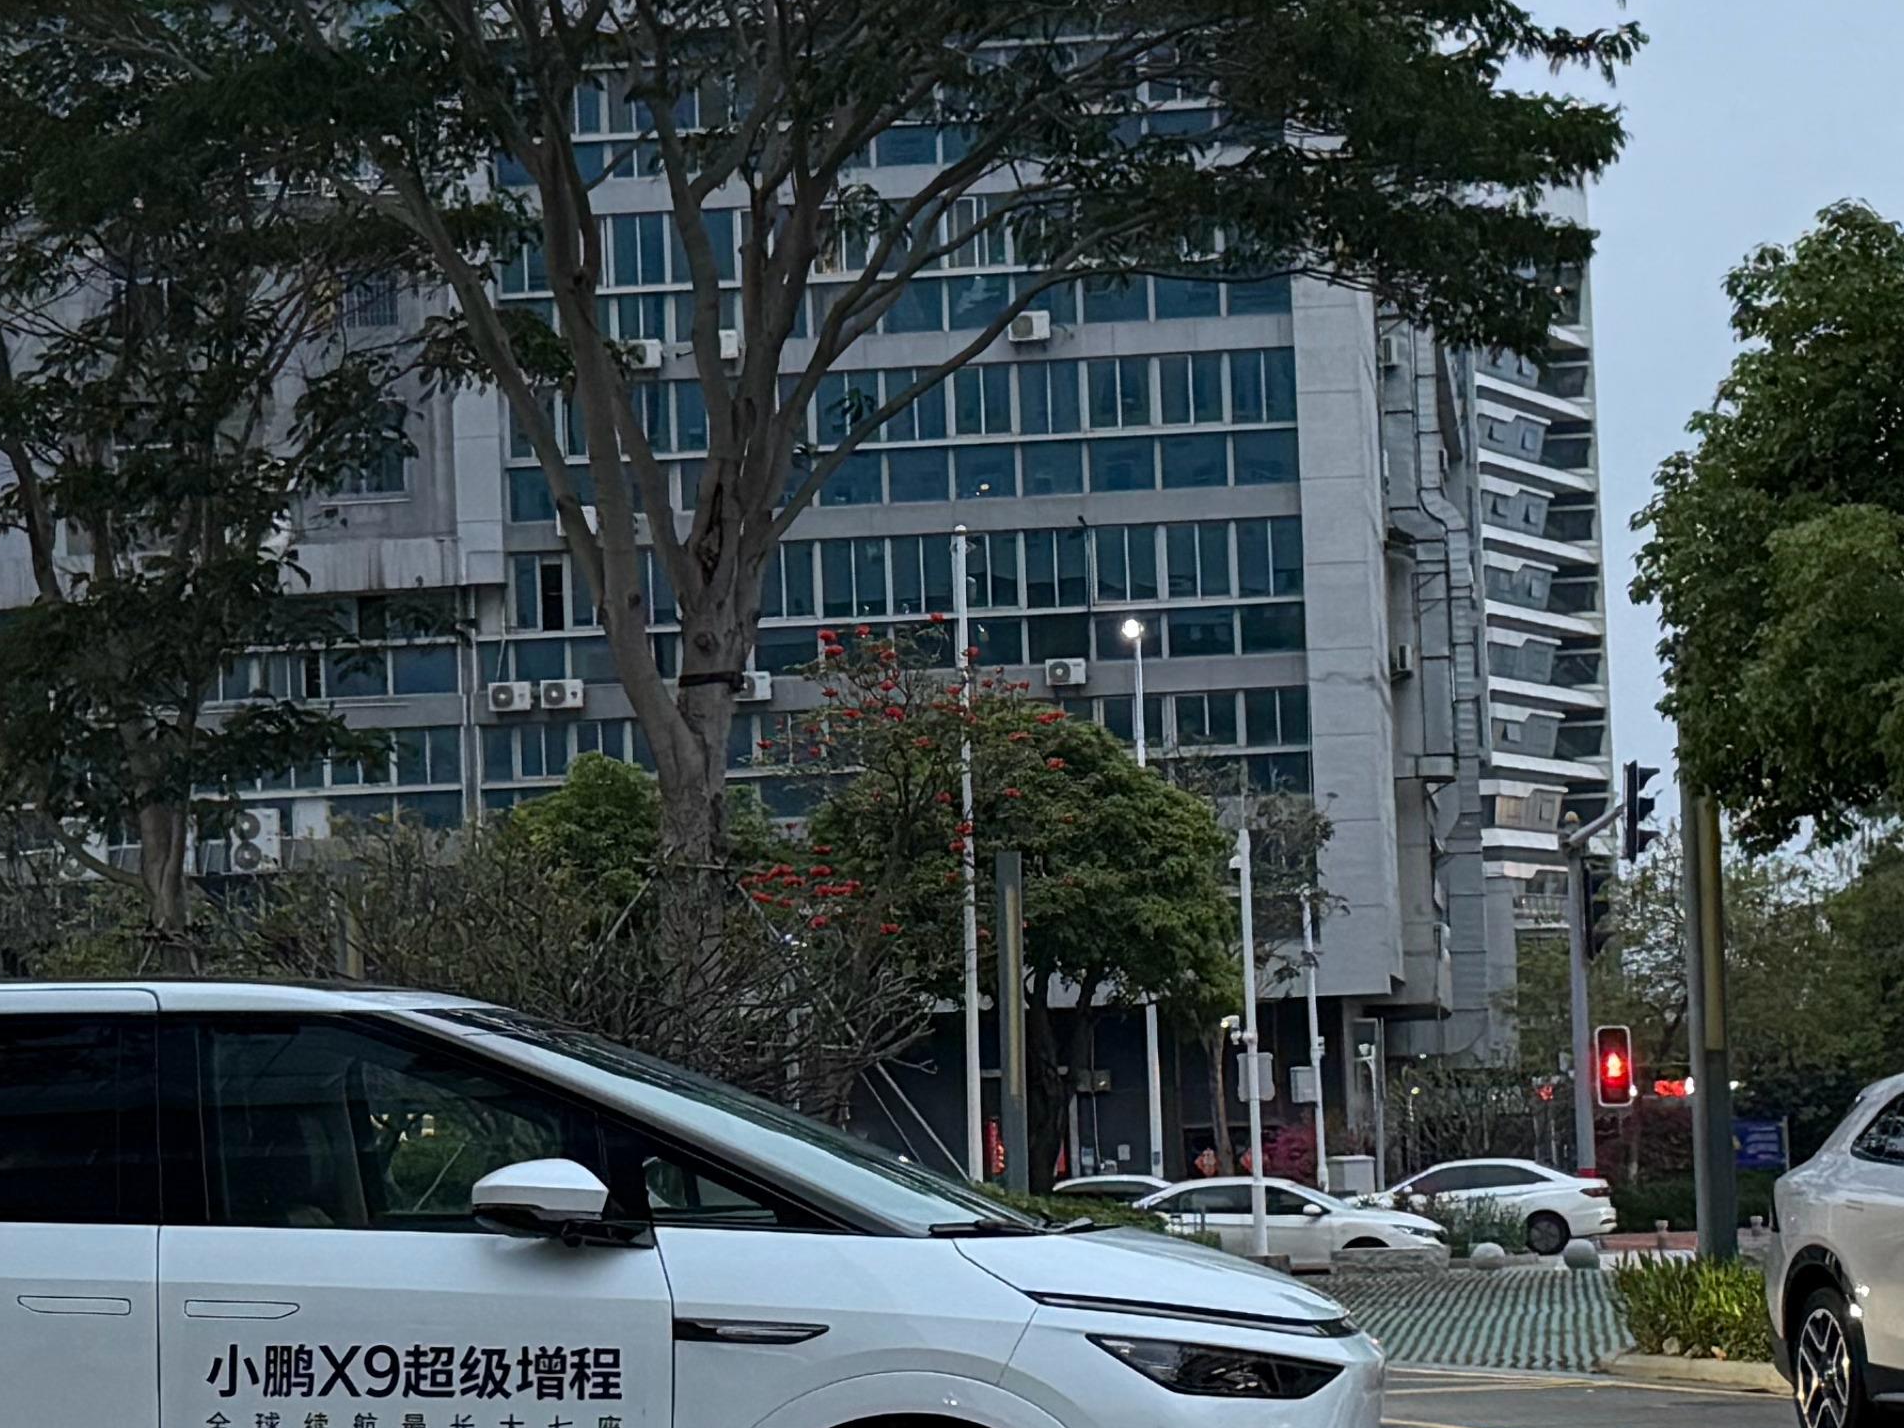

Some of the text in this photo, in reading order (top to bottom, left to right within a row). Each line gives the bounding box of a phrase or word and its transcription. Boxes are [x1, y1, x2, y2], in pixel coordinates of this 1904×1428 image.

[206, 1344, 624, 1400] 小鹏X9超级增程
